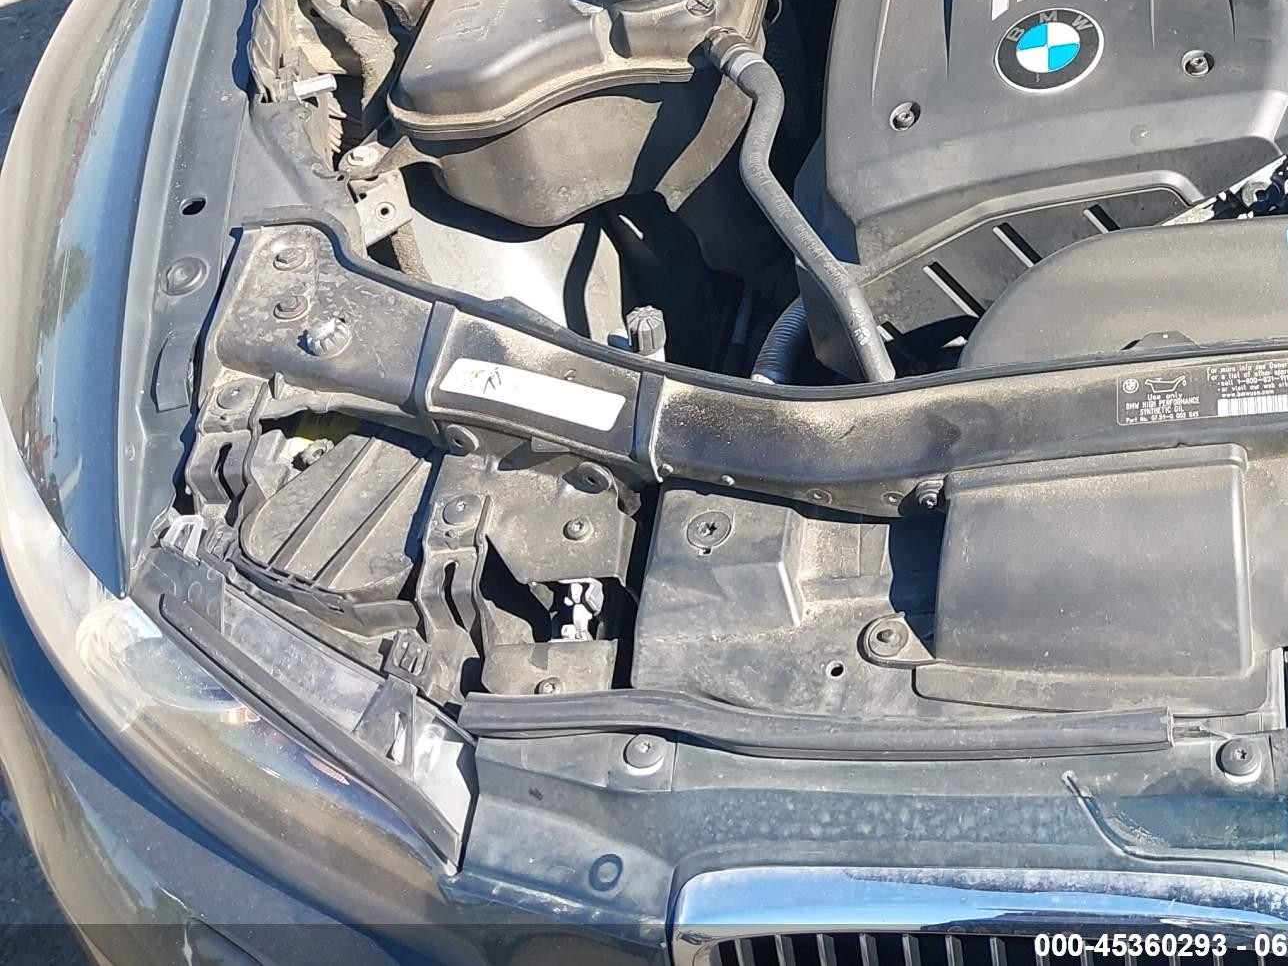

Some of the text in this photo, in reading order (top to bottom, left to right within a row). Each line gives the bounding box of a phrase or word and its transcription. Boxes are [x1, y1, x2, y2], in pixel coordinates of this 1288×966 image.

[1239, 364, 1252, 372] info
[1147, 391, 1183, 401] Use only
[1125, 396, 1200, 410] BMW HIGH PERFORMANCE
[1140, 405, 1184, 416] SYNTHETIC OIL
